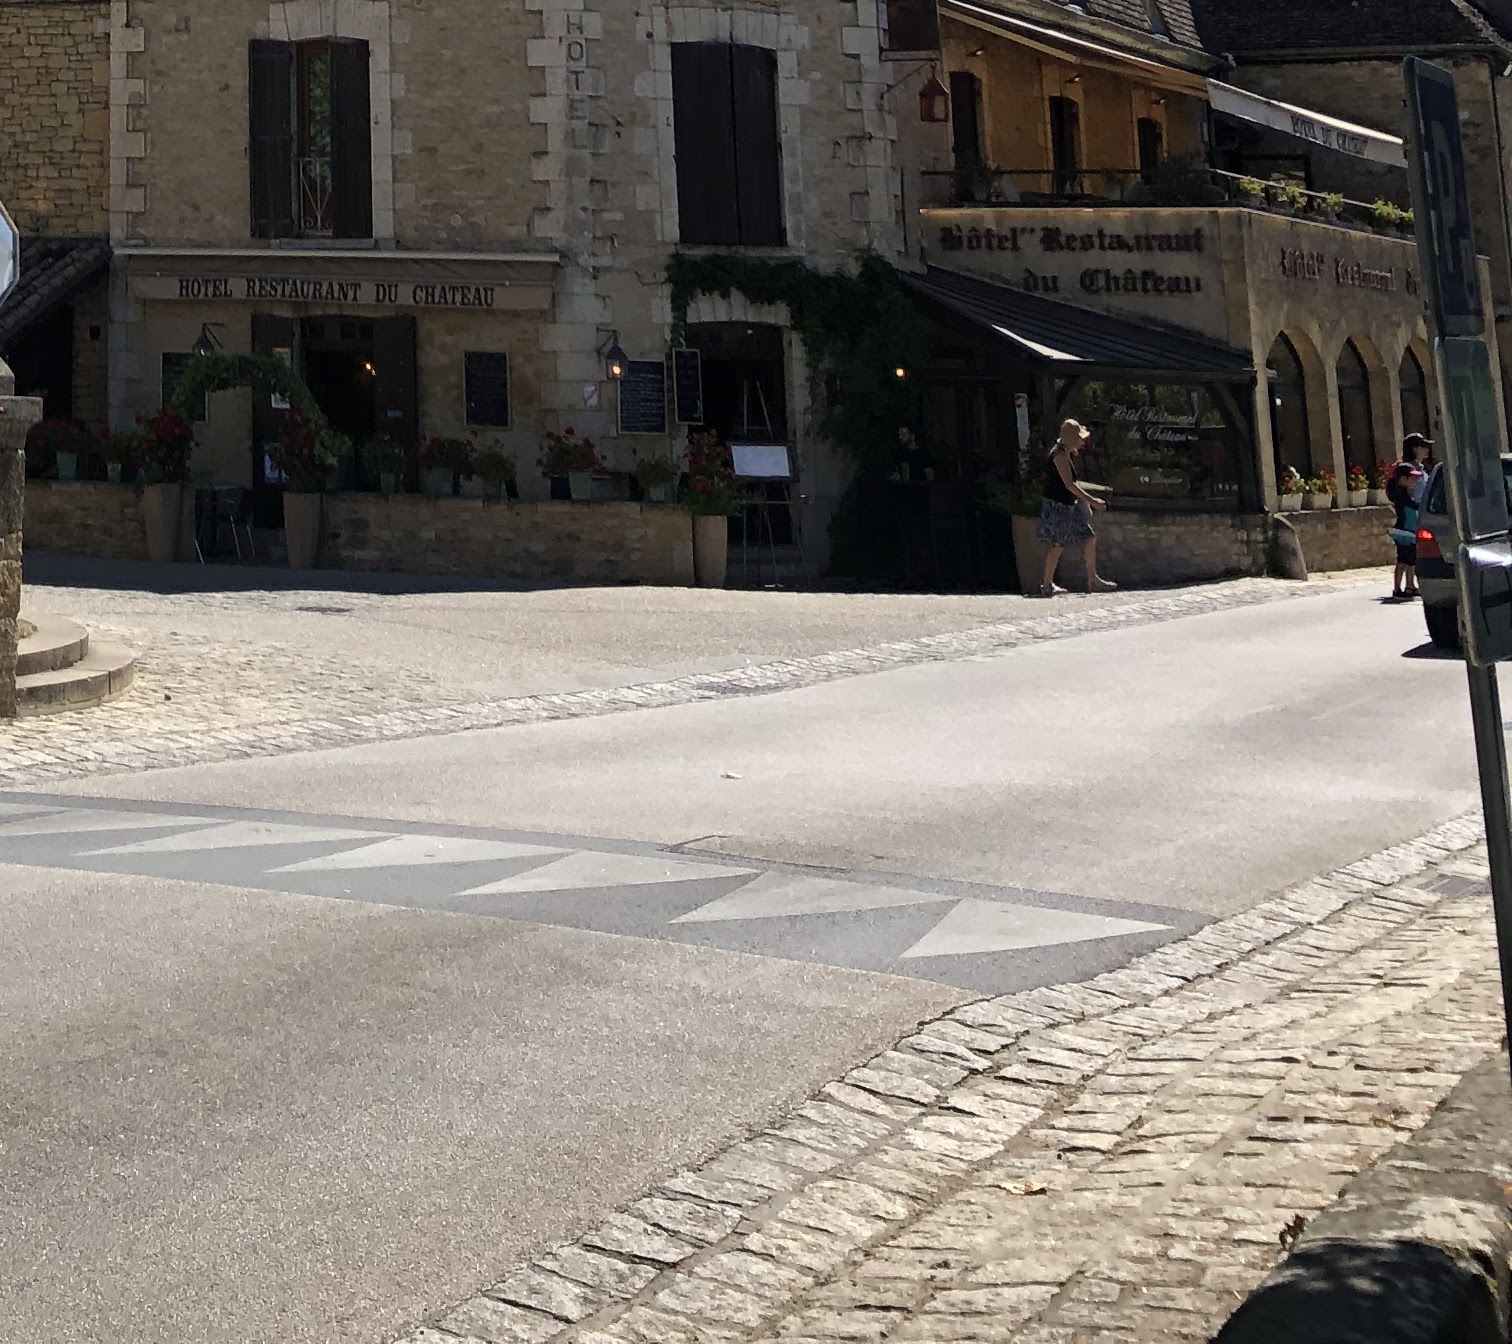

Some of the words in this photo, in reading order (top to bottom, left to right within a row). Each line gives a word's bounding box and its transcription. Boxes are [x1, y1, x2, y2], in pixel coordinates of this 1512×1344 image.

[566, 13, 587, 150] HOTEL
[179, 278, 232, 298] HOTEL
[246, 278, 361, 303] RESTAURANT
[375, 283, 398, 303] DU
[413, 284, 495, 307] CHATEAU
